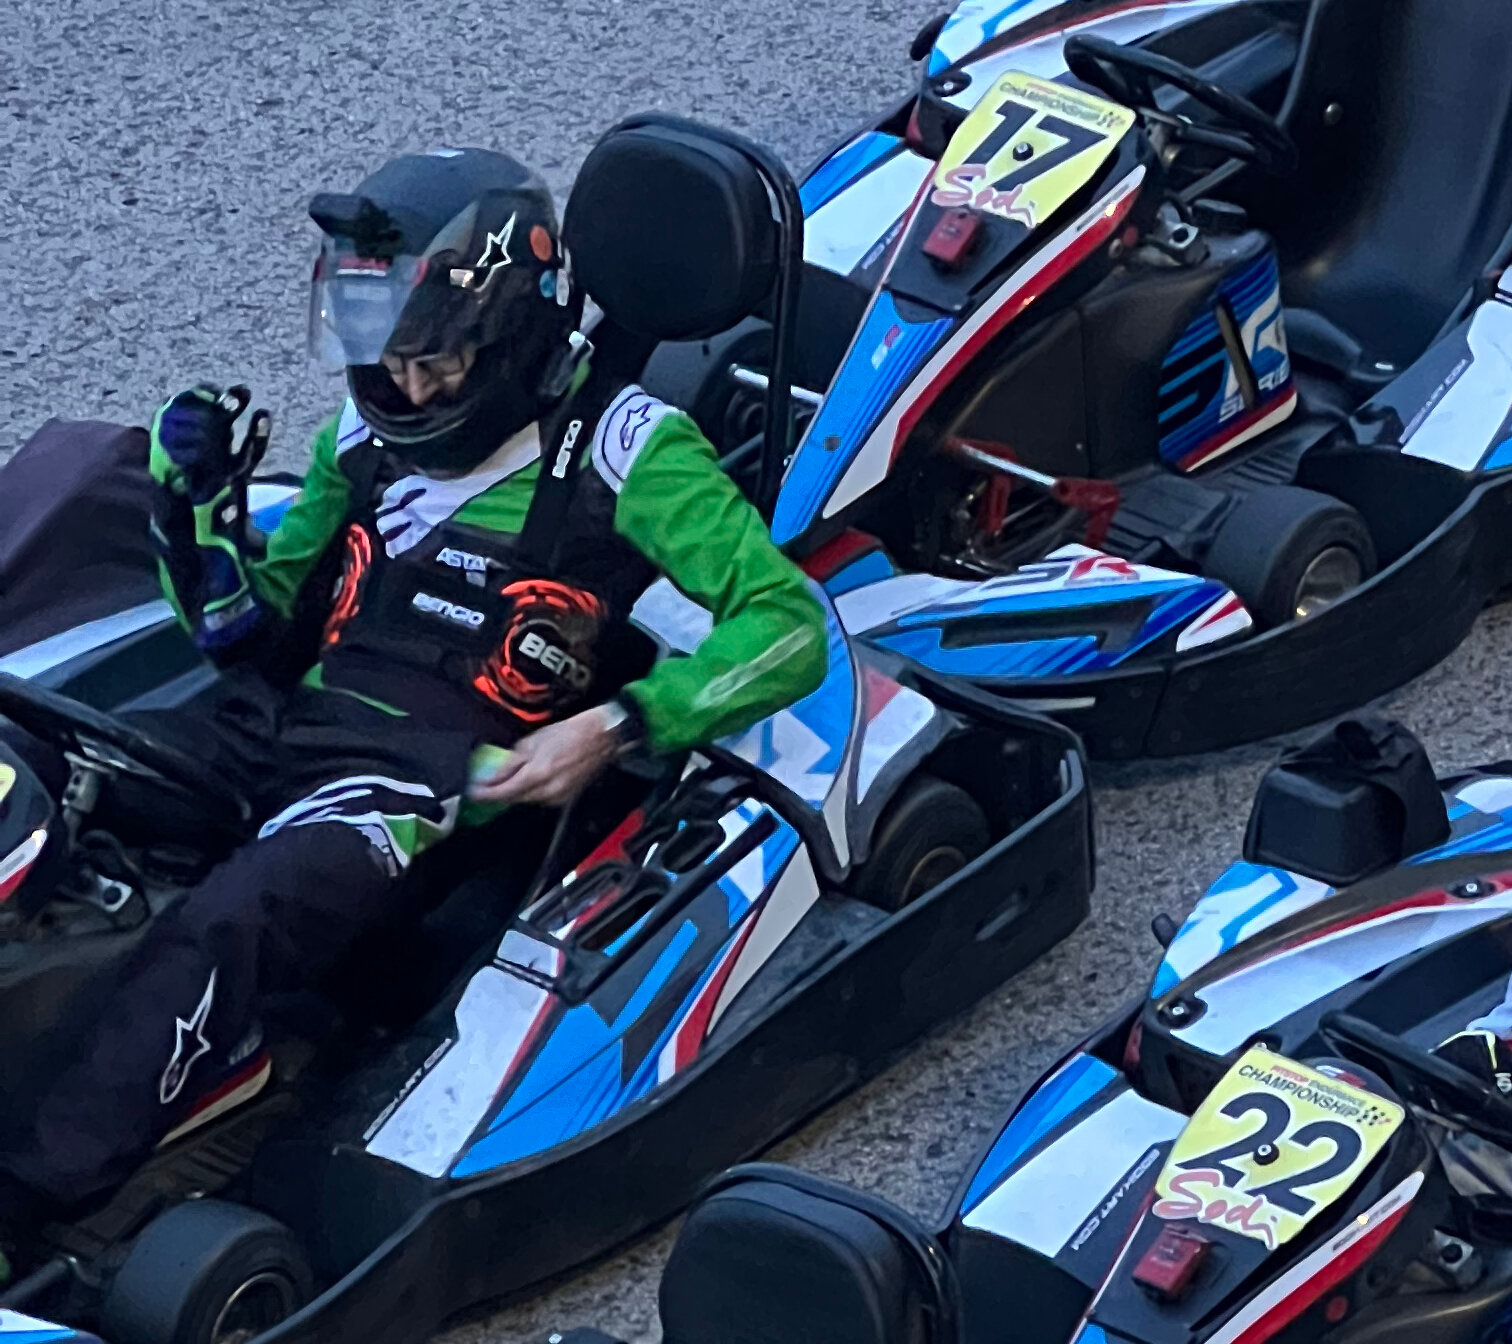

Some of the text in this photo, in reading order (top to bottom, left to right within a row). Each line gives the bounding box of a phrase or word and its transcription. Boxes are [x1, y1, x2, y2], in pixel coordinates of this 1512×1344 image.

[963, 100, 1109, 191] 17
[931, 163, 1037, 229] Sodi
[1238, 1064, 1360, 1119] CHAMPIONSHIP
[1175, 1092, 1363, 1216] 22
[1154, 1170, 1278, 1249] Sodi
